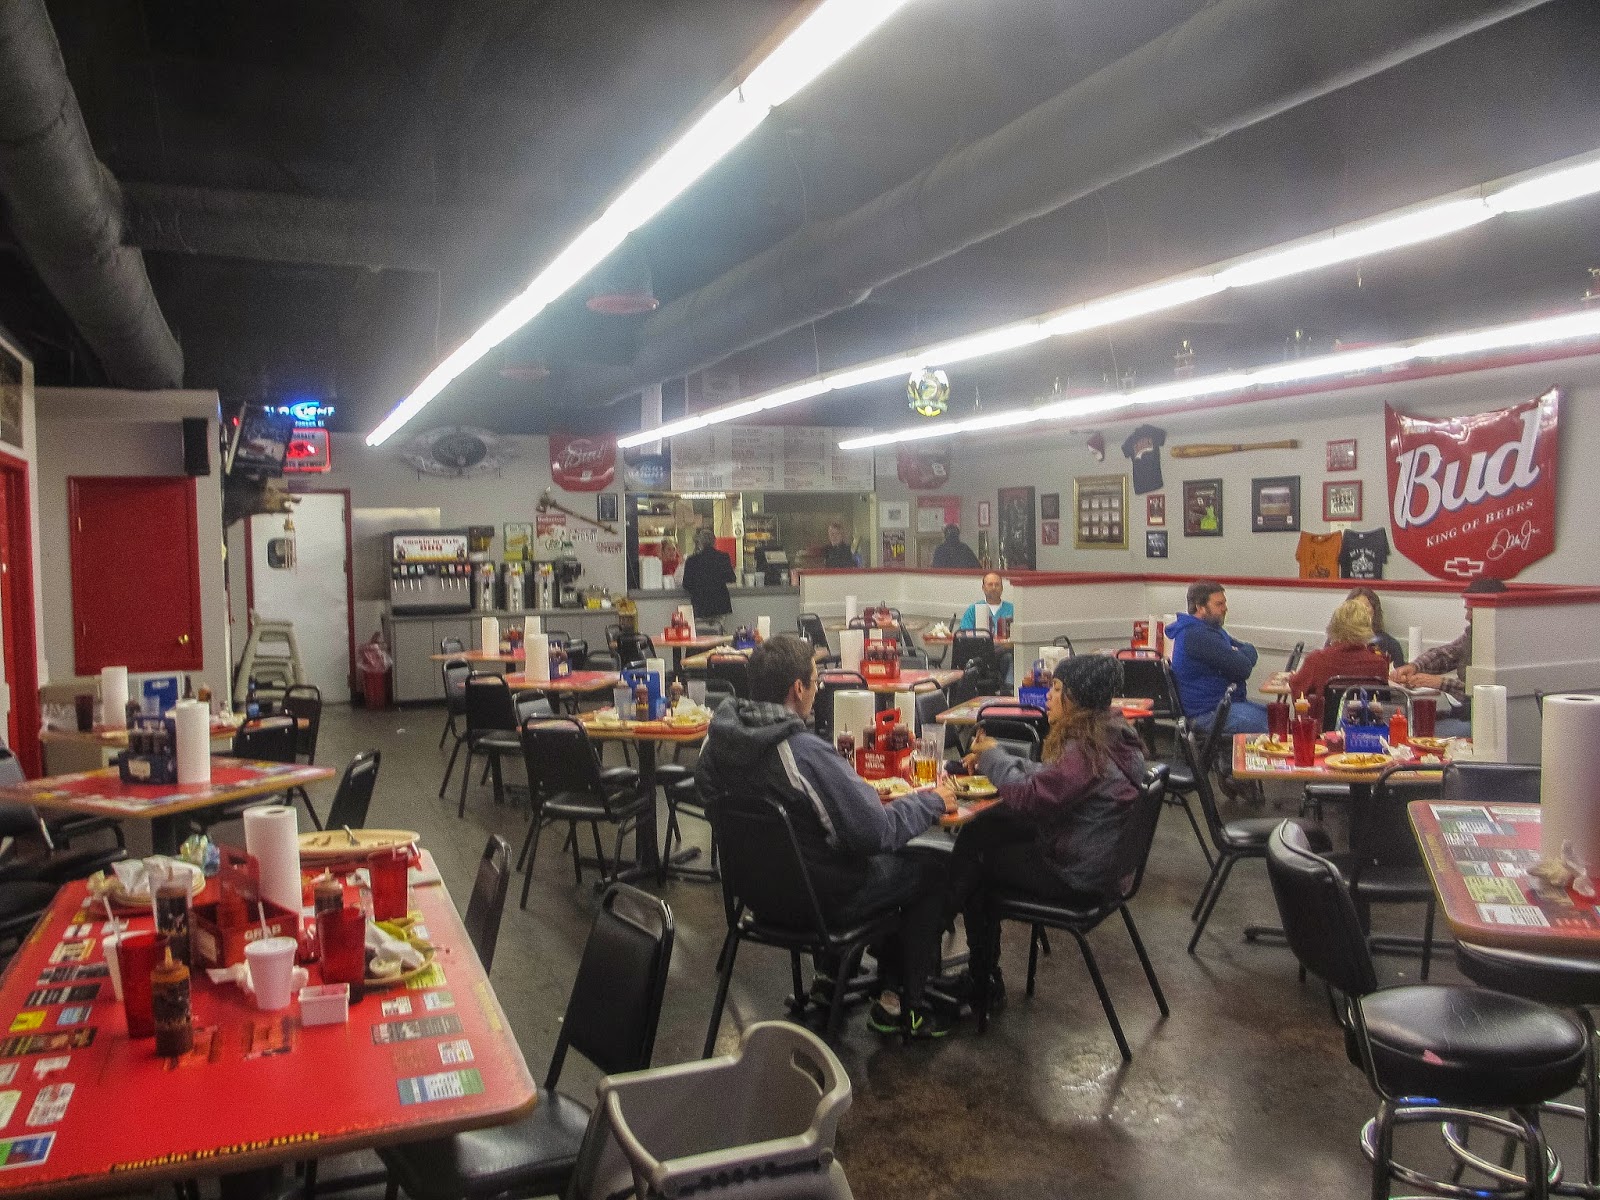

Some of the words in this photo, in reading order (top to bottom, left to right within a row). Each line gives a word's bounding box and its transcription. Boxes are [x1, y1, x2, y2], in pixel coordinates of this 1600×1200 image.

[1394, 406, 1540, 529] Bud
[1426, 526, 1458, 548] KING
[1461, 518, 1480, 534] OF
[1484, 498, 1534, 524] BEERS
